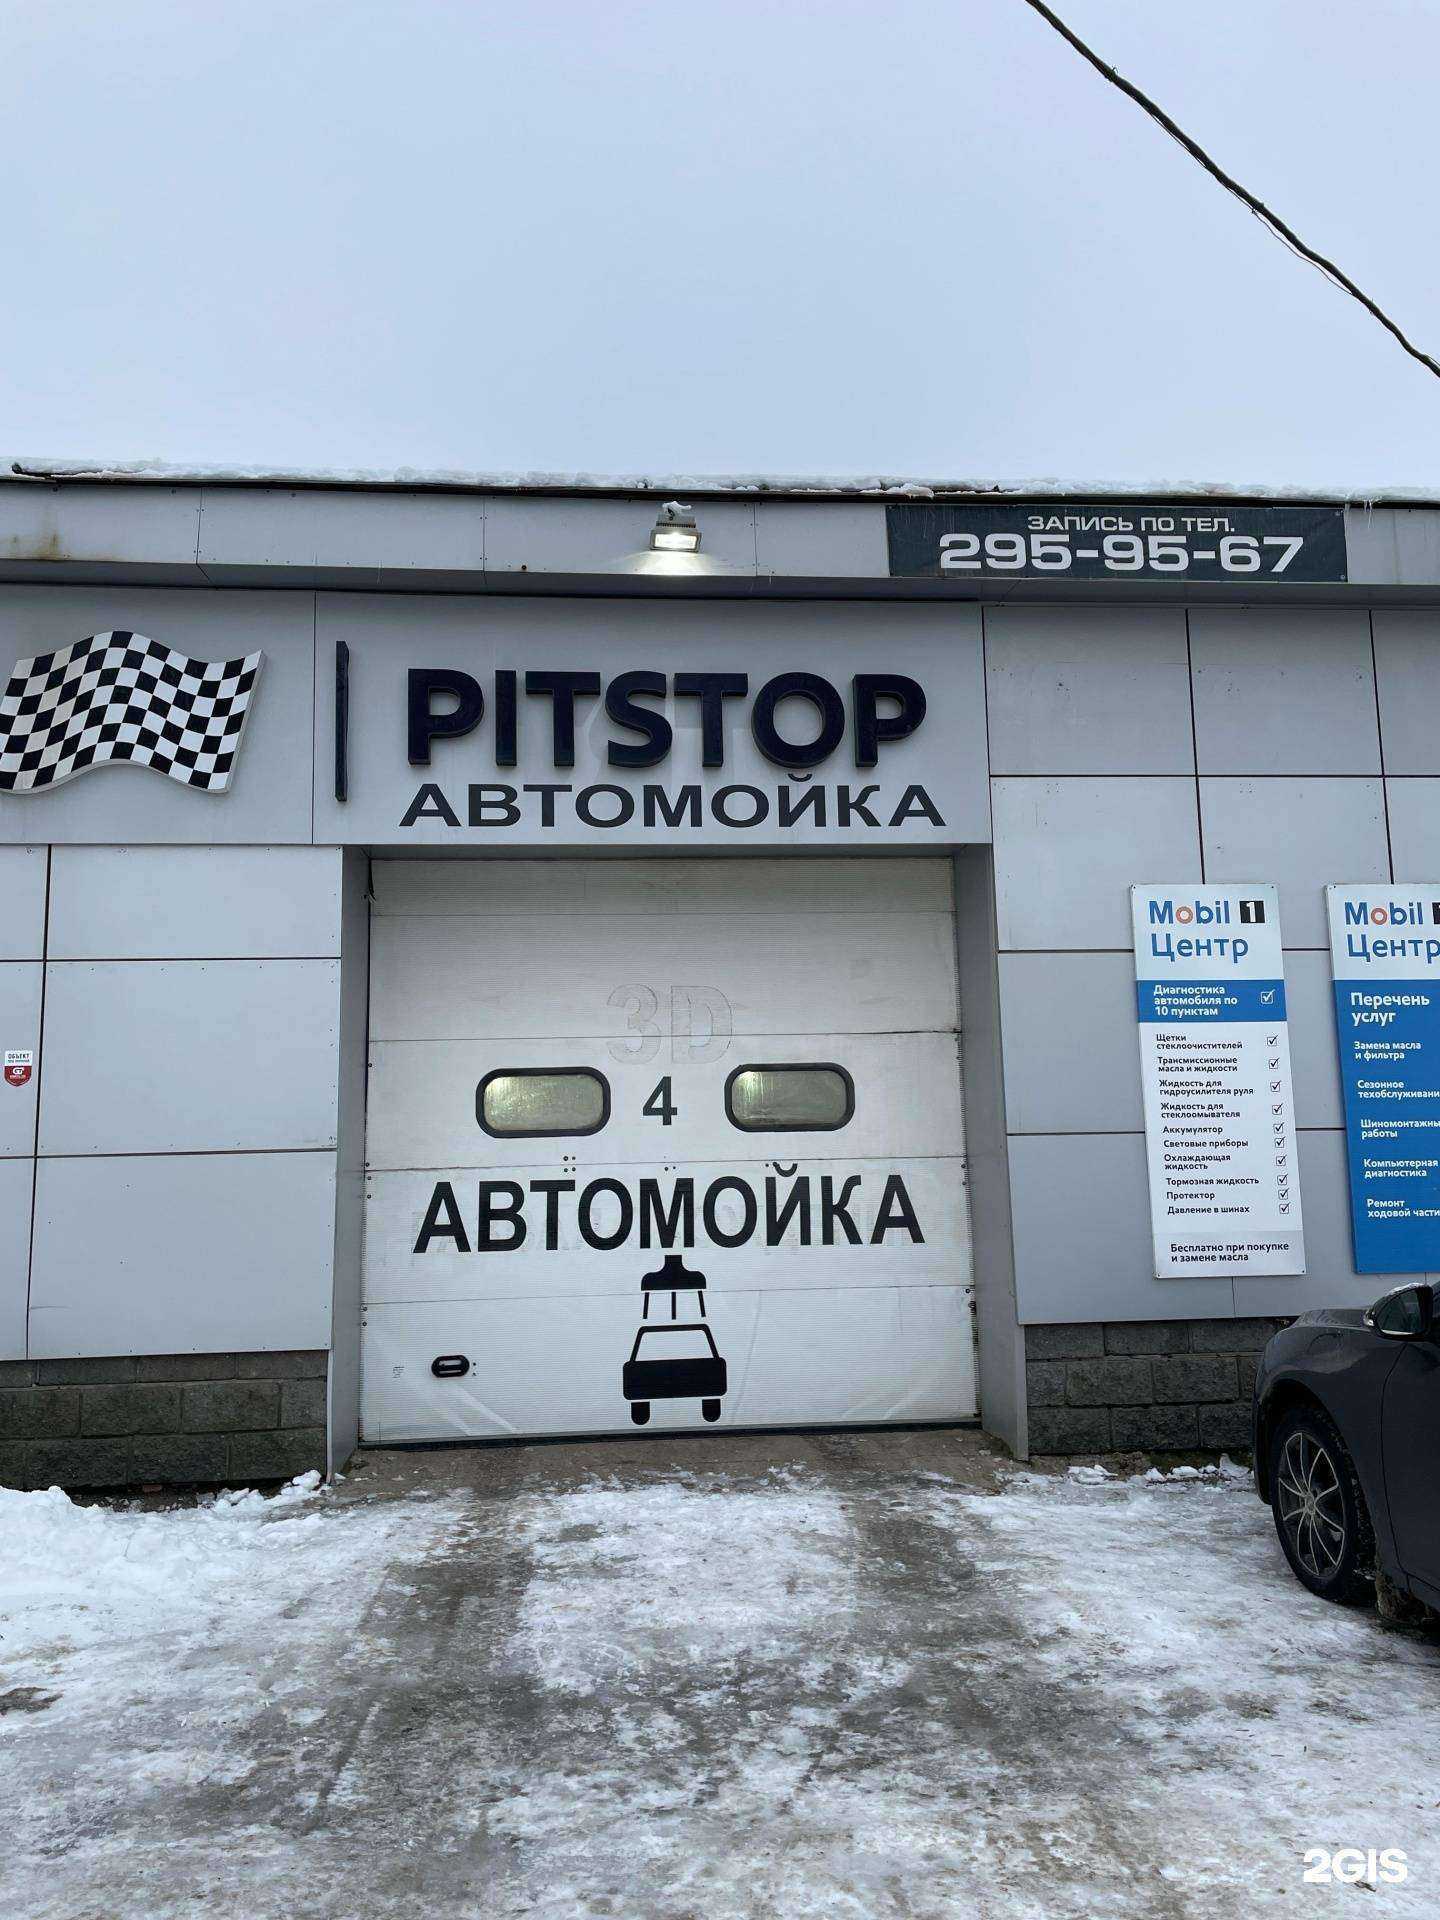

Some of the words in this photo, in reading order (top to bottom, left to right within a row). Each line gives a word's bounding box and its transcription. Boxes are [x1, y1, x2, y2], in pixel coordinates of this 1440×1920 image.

[1027, 515, 1134, 532] ЗАПИСЬ
[1140, 517, 1175, 532] ПО
[1181, 517, 1235, 533] ТЕЛ.
[939, 533, 1304, 573] 295-95-67
[407, 668, 927, 770] PITSTOP
[400, 773, 947, 828] АВТОМОЙКА
[1149, 900, 1230, 925] Mobil
[1344, 901, 1424, 926] Mobil
[1151, 933, 1249, 963] Центр
[1347, 934, 1440, 964] Центр
[1153, 984, 1226, 996] Диагностика
[1154, 994, 1222, 1006] автомобиля
[1224, 997, 1238, 1006] по
[1350, 991, 1430, 1007] Перечень
[1155, 1006, 1168, 1016] 10
[1171, 1007, 1219, 1018] пунктам
[1352, 1011, 1396, 1027] услуг
[1156, 1033, 1187, 1042] Щетки
[1157, 1041, 1243, 1050] стеклоочистителей
[1354, 1041, 1390, 1050] Замена
[1391, 1040, 1421, 1050] масла
[1158, 1056, 1238, 1066] Трансмиссионные
[1355, 1052, 1361, 1060] и
[1364, 1050, 1405, 1062] фильтра
[1158, 1065, 1184, 1073] масла
[1194, 1064, 1238, 1074] жидкости
[1159, 1079, 1204, 1089] Жидкость
[1206, 1080, 1222, 1088] для
[1357, 1080, 1405, 1090] Сезонное
[1160, 1088, 1231, 1098] гидроусилителя
[1233, 1087, 1254, 1097] руля
[642, 1076, 678, 1126] 4
[1160, 1102, 1206, 1112] Жидкость
[1207, 1103, 1224, 1112] для
[1161, 1111, 1241, 1119] стеклоомывателя
[1162, 1126, 1223, 1136] Аккумулятор
[1361, 1128, 1398, 1140] работы
[1163, 1139, 1207, 1148] Световые
[1209, 1138, 1249, 1149] приборы
[1164, 1153, 1231, 1163] Охлаждающая
[1363, 1158, 1439, 1168] Компьютерная
[1164, 1163, 1209, 1171] жидкость
[1364, 1168, 1427, 1179] диагностика
[1166, 1177, 1215, 1187] Тормозная
[1216, 1177, 1260, 1186] жидкость
[1166, 1191, 1216, 1201] Протектор
[413, 1163, 925, 1254] АВТОМОЙКА
[1366, 1198, 1405, 1208] Ремонт
[1167, 1206, 1212, 1216] Давление
[1220, 1205, 1250, 1213] шинах
[1367, 1207, 1411, 1219] ходовой
[1413, 1208, 1440, 1217] части
[1170, 1242, 1223, 1254] Бесплатно
[1226, 1243, 1246, 1254] при
[1247, 1241, 1289, 1253] покупке
[1180, 1255, 1217, 1263] замене
[1219, 1254, 1249, 1262] масла
